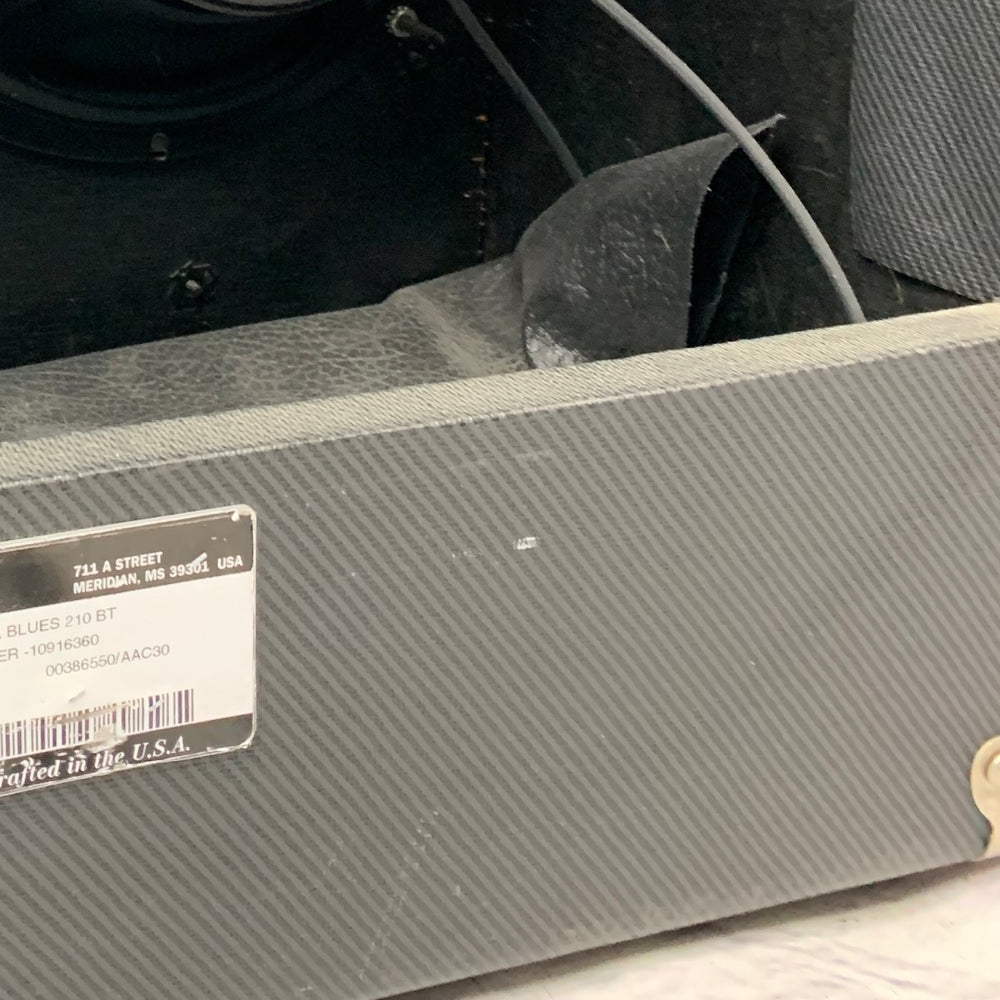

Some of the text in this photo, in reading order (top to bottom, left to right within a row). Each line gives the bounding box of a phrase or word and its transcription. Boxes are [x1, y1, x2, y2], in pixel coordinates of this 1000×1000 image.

[73, 551, 163, 578] 711 A STREET
[73, 555, 243, 595] MERIDIAN, MS 39301 USA
[6, 617, 60, 638] BLUES
[65, 612, 91, 628] 210
[96, 607, 117, 622] BT
[46, 644, 170, 677] 00386550/AAC30
[67, 755, 88, 775] in
[94, 750, 125, 769] the
[132, 735, 190, 762] U.S.A.
